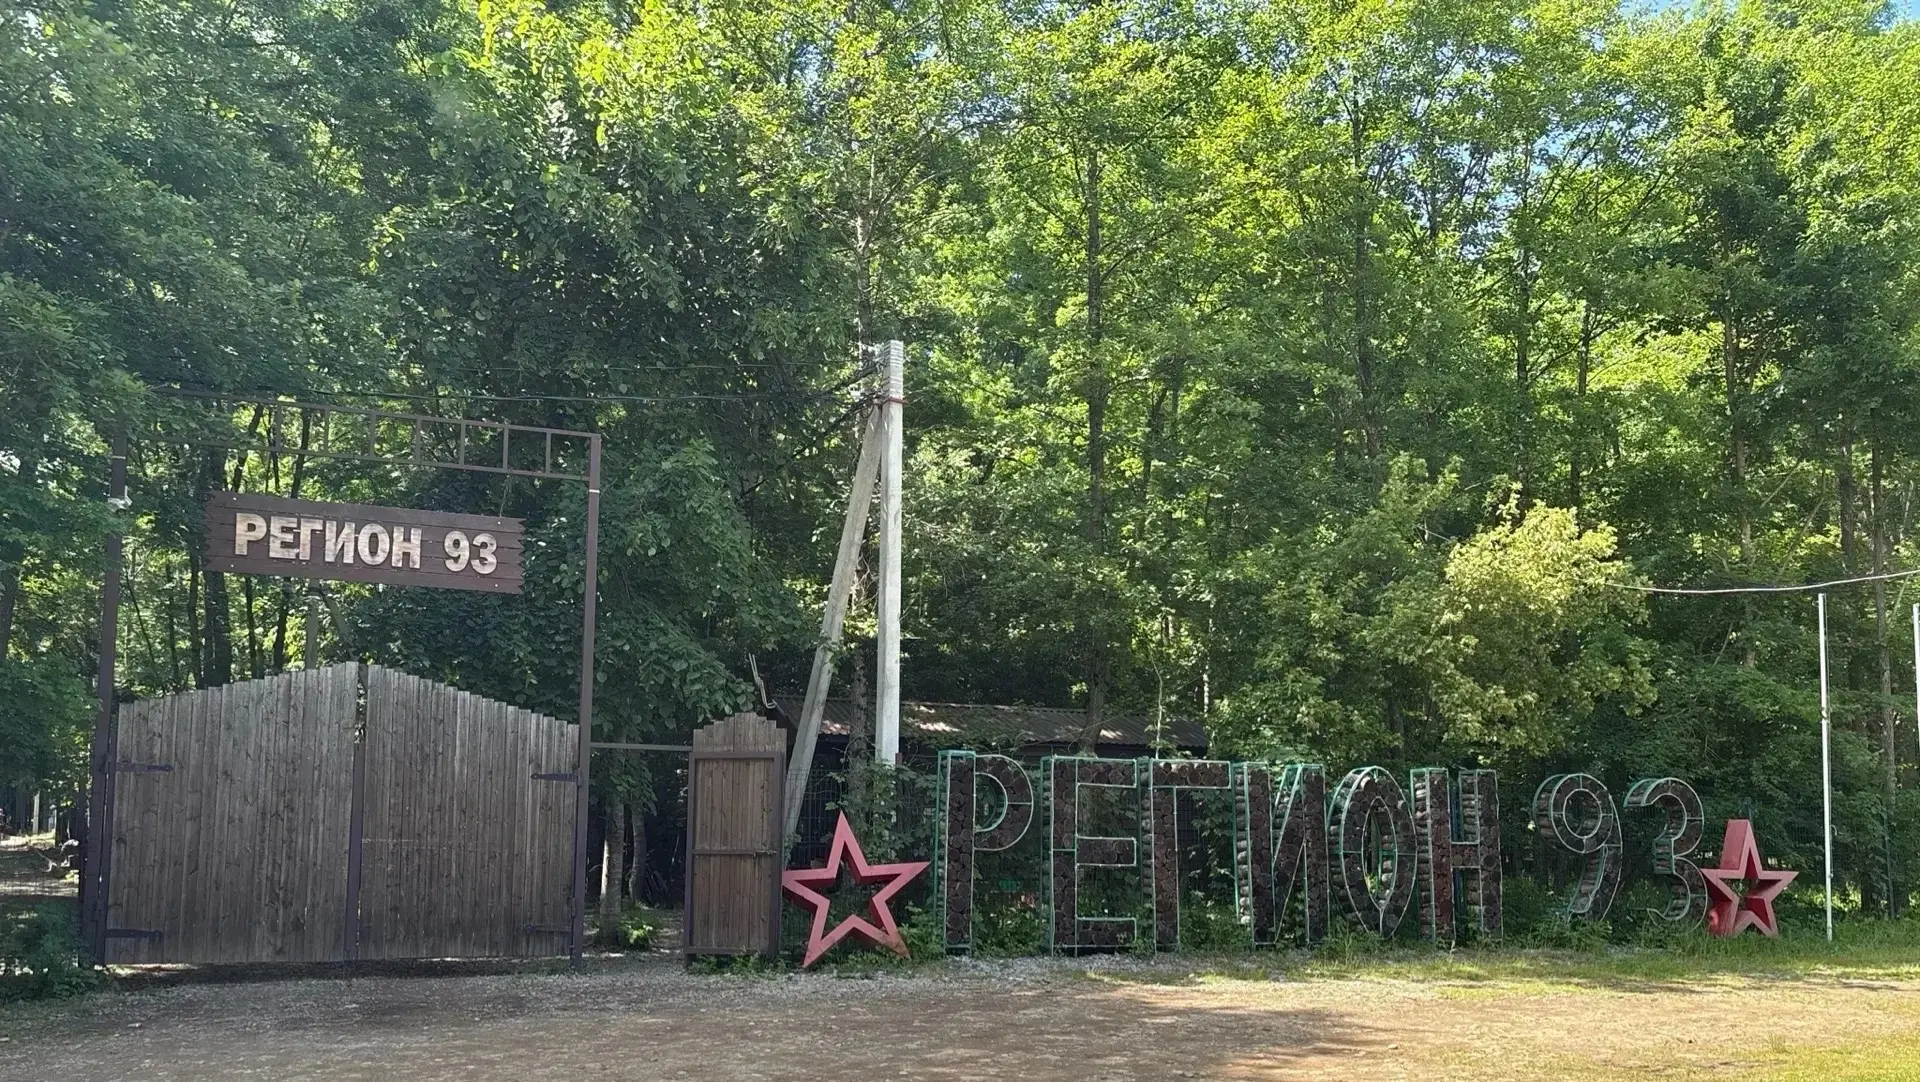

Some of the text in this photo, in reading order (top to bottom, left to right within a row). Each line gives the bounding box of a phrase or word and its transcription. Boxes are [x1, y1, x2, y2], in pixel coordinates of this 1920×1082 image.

[234, 512, 498, 575] РЕГИОН 93
[935, 750, 1708, 954] РЕГИОН 93
